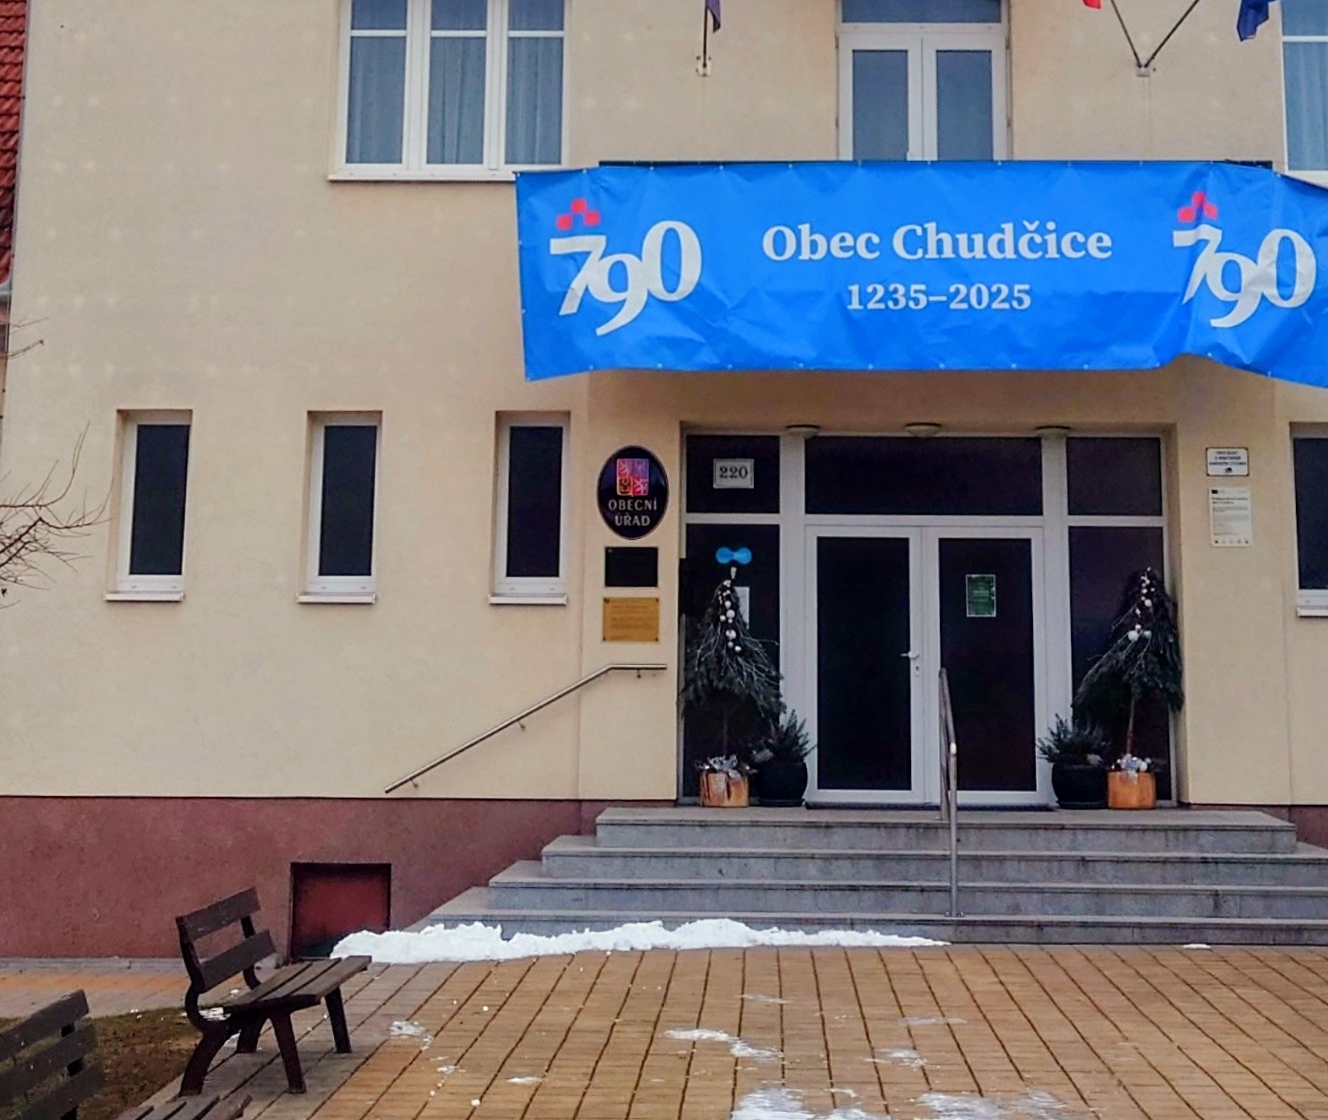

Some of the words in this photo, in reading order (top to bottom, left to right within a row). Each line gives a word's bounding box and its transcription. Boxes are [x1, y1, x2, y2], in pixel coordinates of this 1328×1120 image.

[762, 223, 881, 261] Obec
[892, 220, 1113, 260] Chudčice
[549, 220, 702, 336] 790
[1173, 224, 1317, 328] 790
[719, 466, 749, 480] 220
[608, 496, 658, 511] OBECNÍ
[614, 512, 651, 527] ÚŘAD
